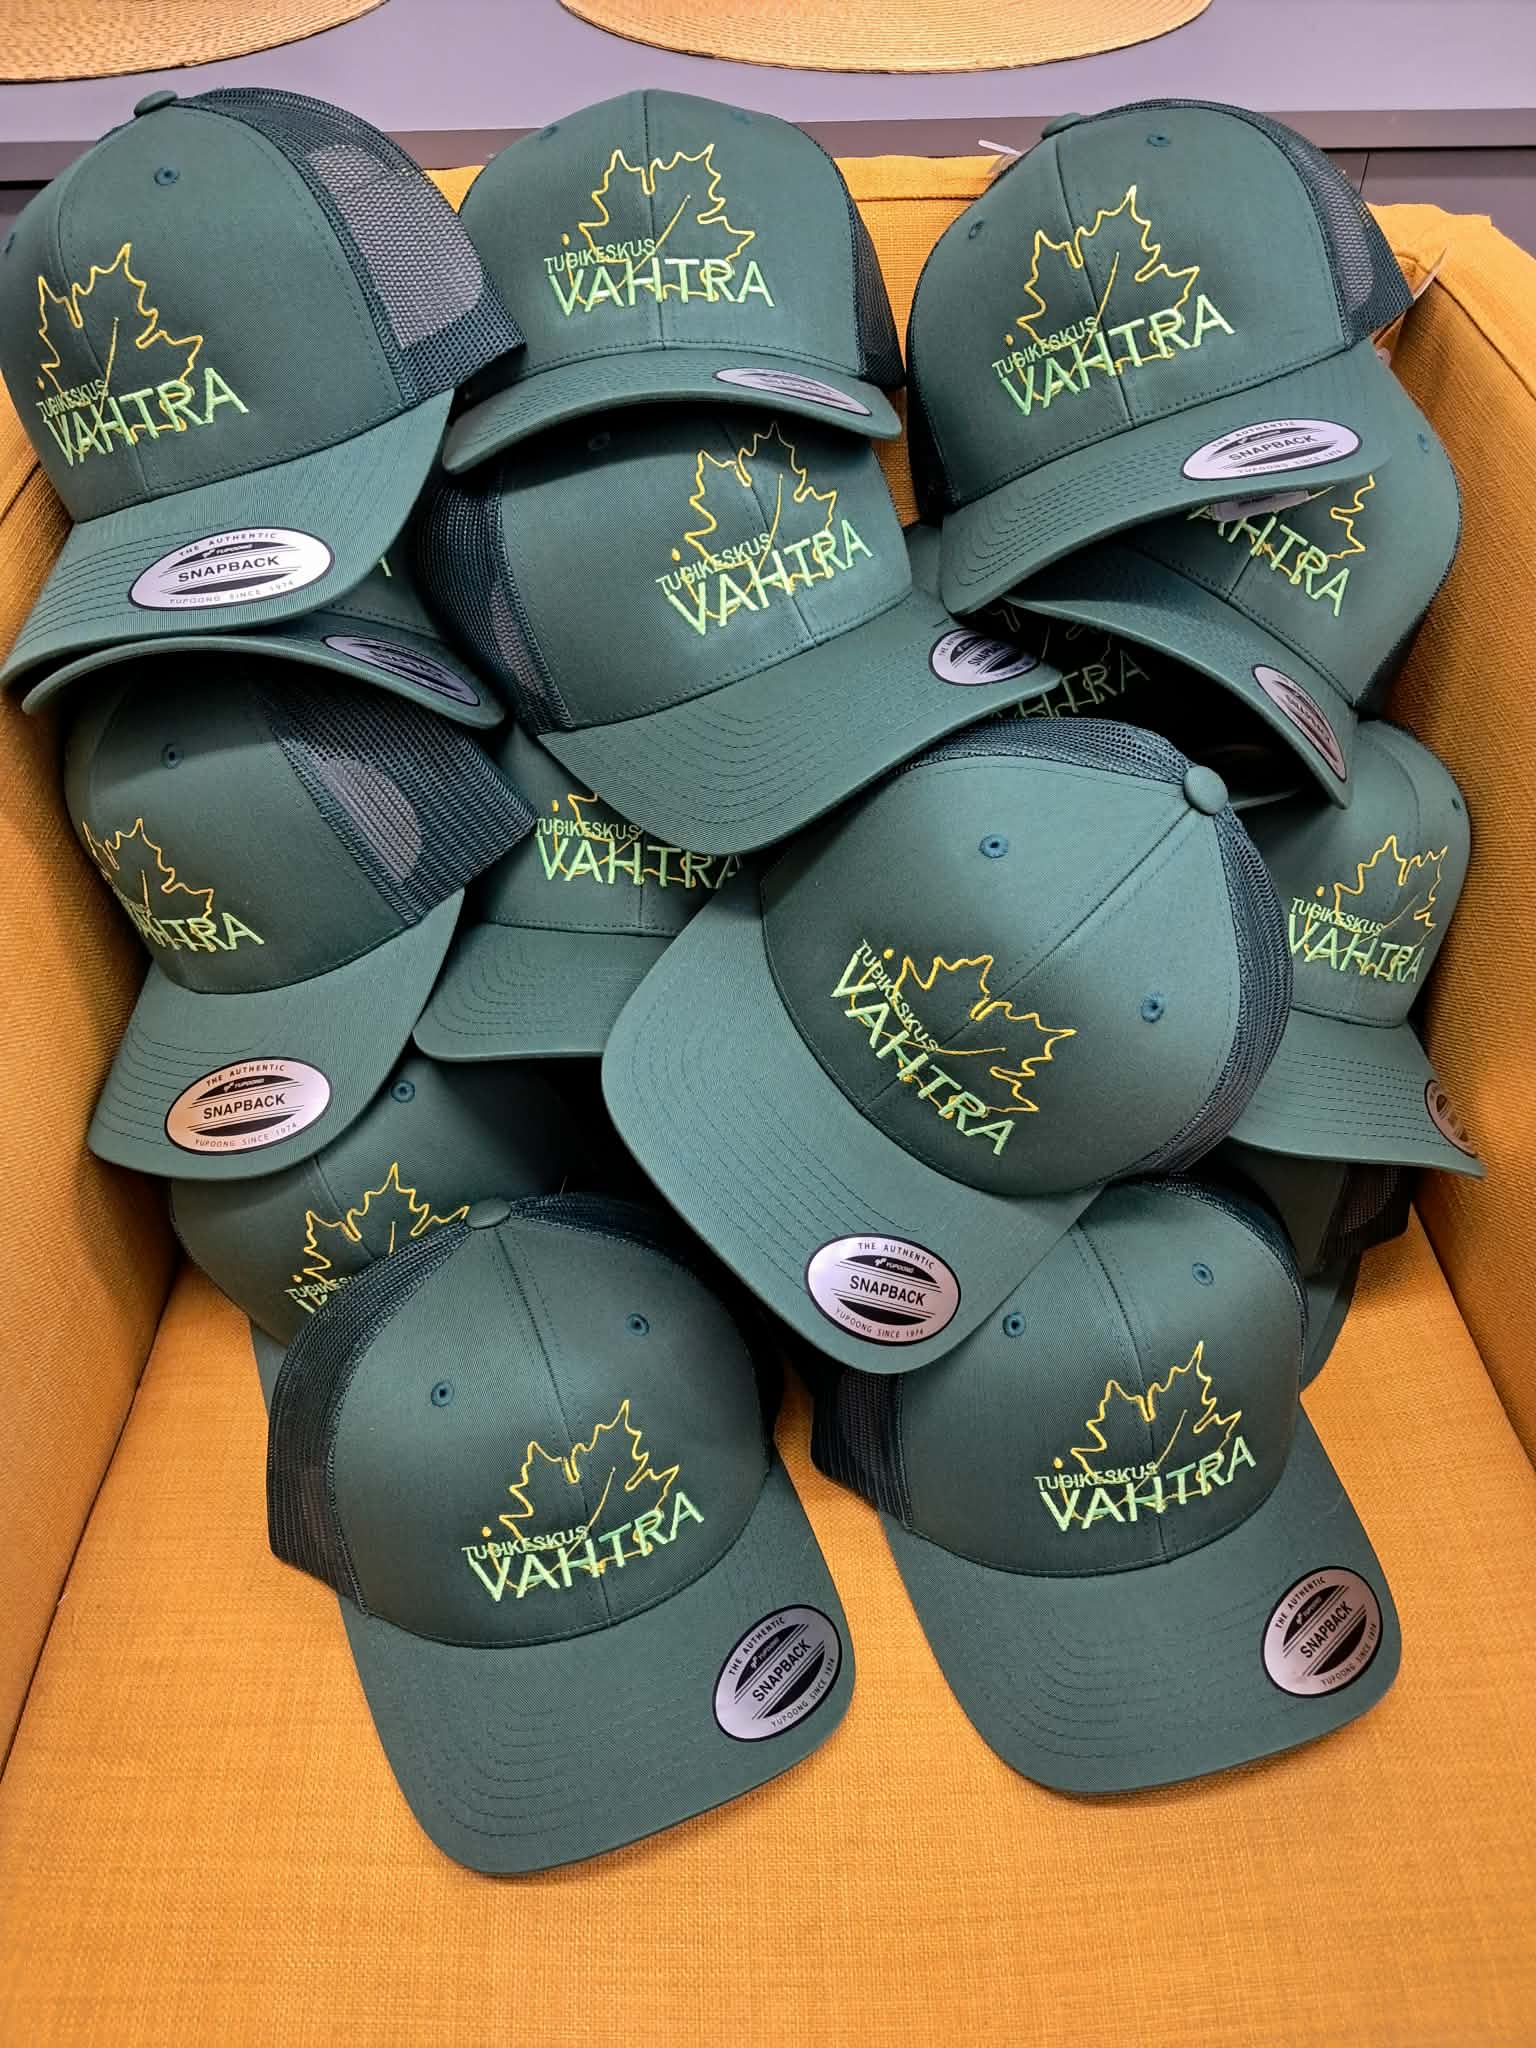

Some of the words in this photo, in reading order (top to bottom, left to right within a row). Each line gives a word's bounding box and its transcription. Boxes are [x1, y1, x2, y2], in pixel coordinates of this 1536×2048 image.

[544, 238, 656, 274] TUGIKESKUS
[548, 257, 775, 317] VAHTRA
[992, 316, 1097, 378] TUGIKESKUS
[1001, 294, 1235, 416] VAHTRA
[36, 378, 109, 419] TUGIKESKUS
[43, 367, 249, 466] VAHTRA
[1229, 434, 1318, 461] SNAPBACK
[178, 545, 199, 557] THE
[208, 532, 278, 546] AUTHENTIC
[656, 532, 771, 596] TUGIKESKUS
[178, 555, 281, 582] SNAPBACK
[668, 519, 874, 635] VAHTRA
[229, 590, 261, 601] SINCE
[535, 818, 643, 839] TUGIKESKUS
[535, 834, 741, 889] VAHTRA
[1291, 897, 1385, 936] TUGIKESKUS
[1288, 914, 1425, 983] VAHTRA
[856, 939, 938, 1051] TUGIKESKUS
[831, 953, 1015, 1155] VAHTRA
[206, 1074, 223, 1087] THE
[229, 1064, 285, 1077] AUTHENTIC
[203, 1093, 286, 1119] SNAPBACK
[242, 1133, 269, 1146] SINCE
[275, 1121, 297, 1135] 1974
[857, 1242, 877, 1250] THE
[883, 1243, 935, 1271] AUTHENTIC
[850, 1275, 927, 1306] SNAPBACK
[835, 1306, 873, 1333] YUPOONG
[877, 1328, 901, 1338] SINCE
[1033, 1461, 1159, 1491] TUGIKESKUS
[1039, 1436, 1257, 1531] VAHTRA
[461, 1524, 589, 1560] TUGIKESKUS
[468, 1491, 705, 1602] VAHTRA
[1287, 1576, 1326, 1610] AUTHENTIC
[728, 1658, 742, 1675] THE
[743, 1616, 785, 1654] AUTHENTIC
[1300, 1601, 1353, 1658] SNAPBACK
[752, 1640, 812, 1702] SNAPBACK
[770, 1700, 809, 1728] YUPOONG
[810, 1680, 827, 1700] SINCE
